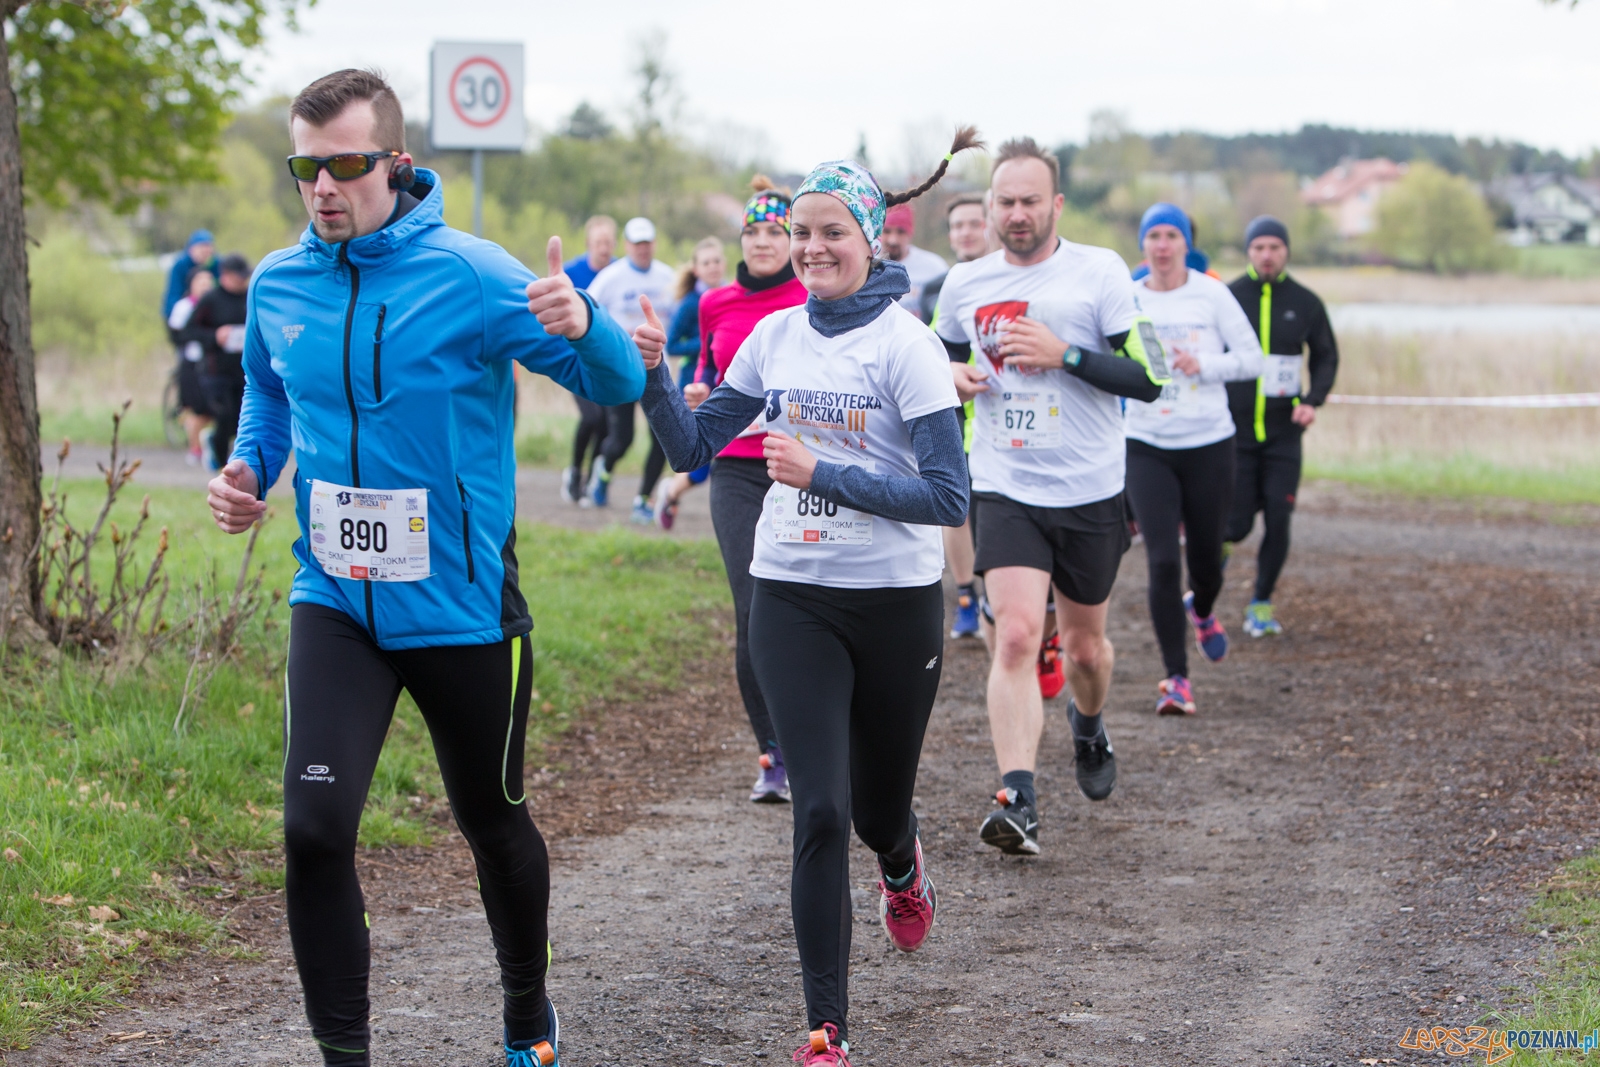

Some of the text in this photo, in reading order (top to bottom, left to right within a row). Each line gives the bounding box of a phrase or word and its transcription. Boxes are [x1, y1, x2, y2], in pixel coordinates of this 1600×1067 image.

[460, 75, 501, 109] 30
[787, 388, 882, 410] UNIWERSYTECKA
[787, 403, 866, 432] ZADYSZKA III
[1005, 409, 1035, 430] 672
[353, 493, 393, 501] UNIWERSYTECKA
[797, 488, 838, 517] 890
[340, 518, 388, 553] 890
[831, 521, 853, 529] 10KM
[328, 552, 344, 561] 5KM
[382, 557, 407, 565] 10KM
[301, 774, 335, 782] Kalenji
